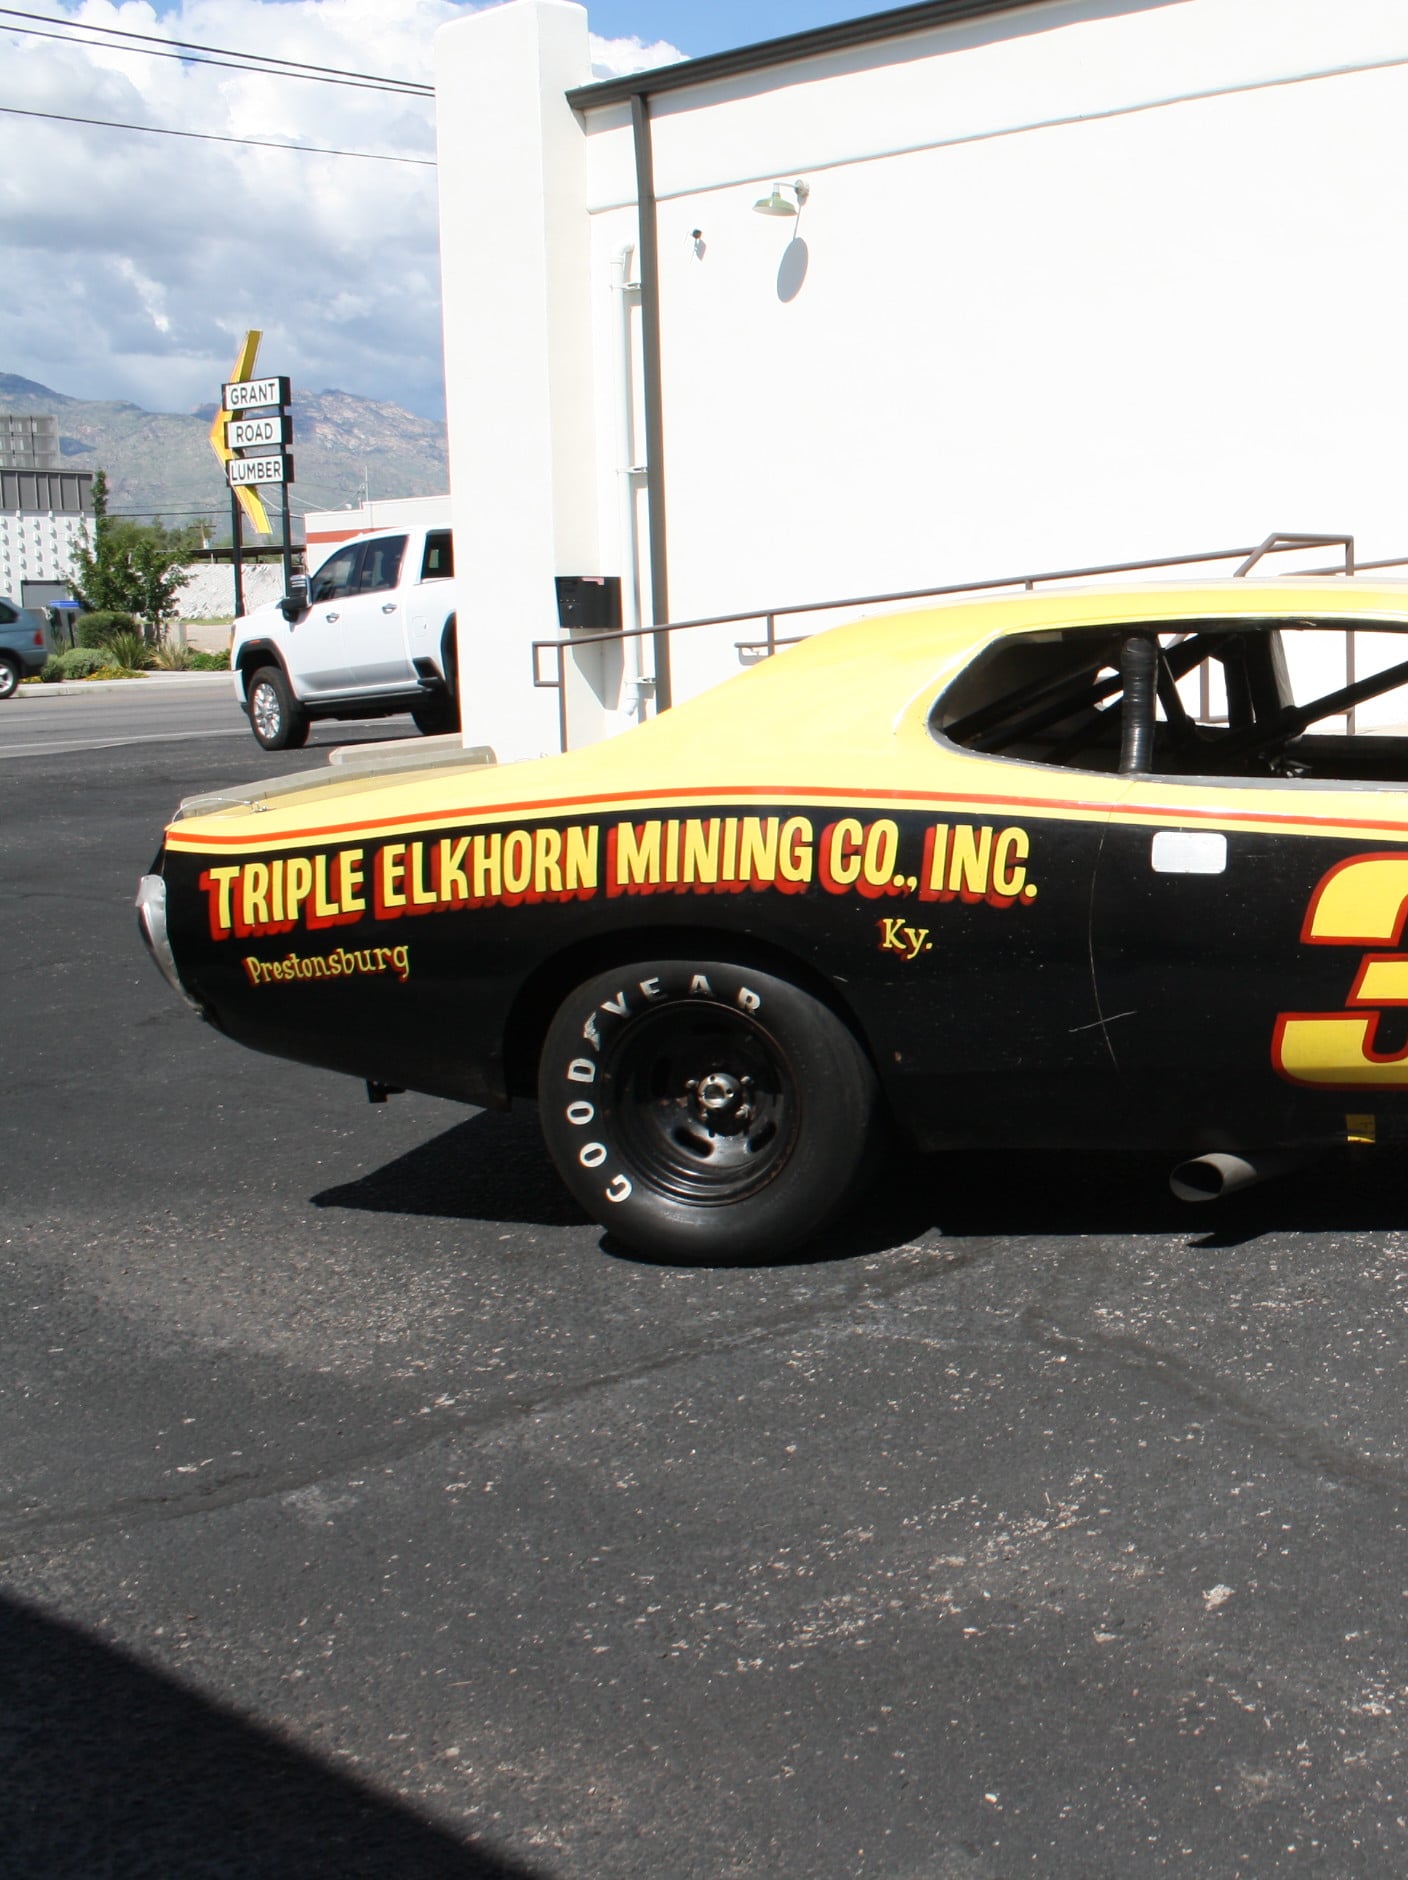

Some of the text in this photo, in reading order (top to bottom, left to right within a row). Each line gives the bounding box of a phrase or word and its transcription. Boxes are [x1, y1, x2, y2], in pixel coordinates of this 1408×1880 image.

[230, 383, 275, 405] GRANT
[236, 423, 273, 442] ROAD
[231, 461, 281, 481] LUMBER
[204, 816, 1038, 935] TRIPLE ELKHORN MINING CO., INC.
[881, 917, 934, 959] Ky.
[244, 944, 410, 985] Prestonsburg
